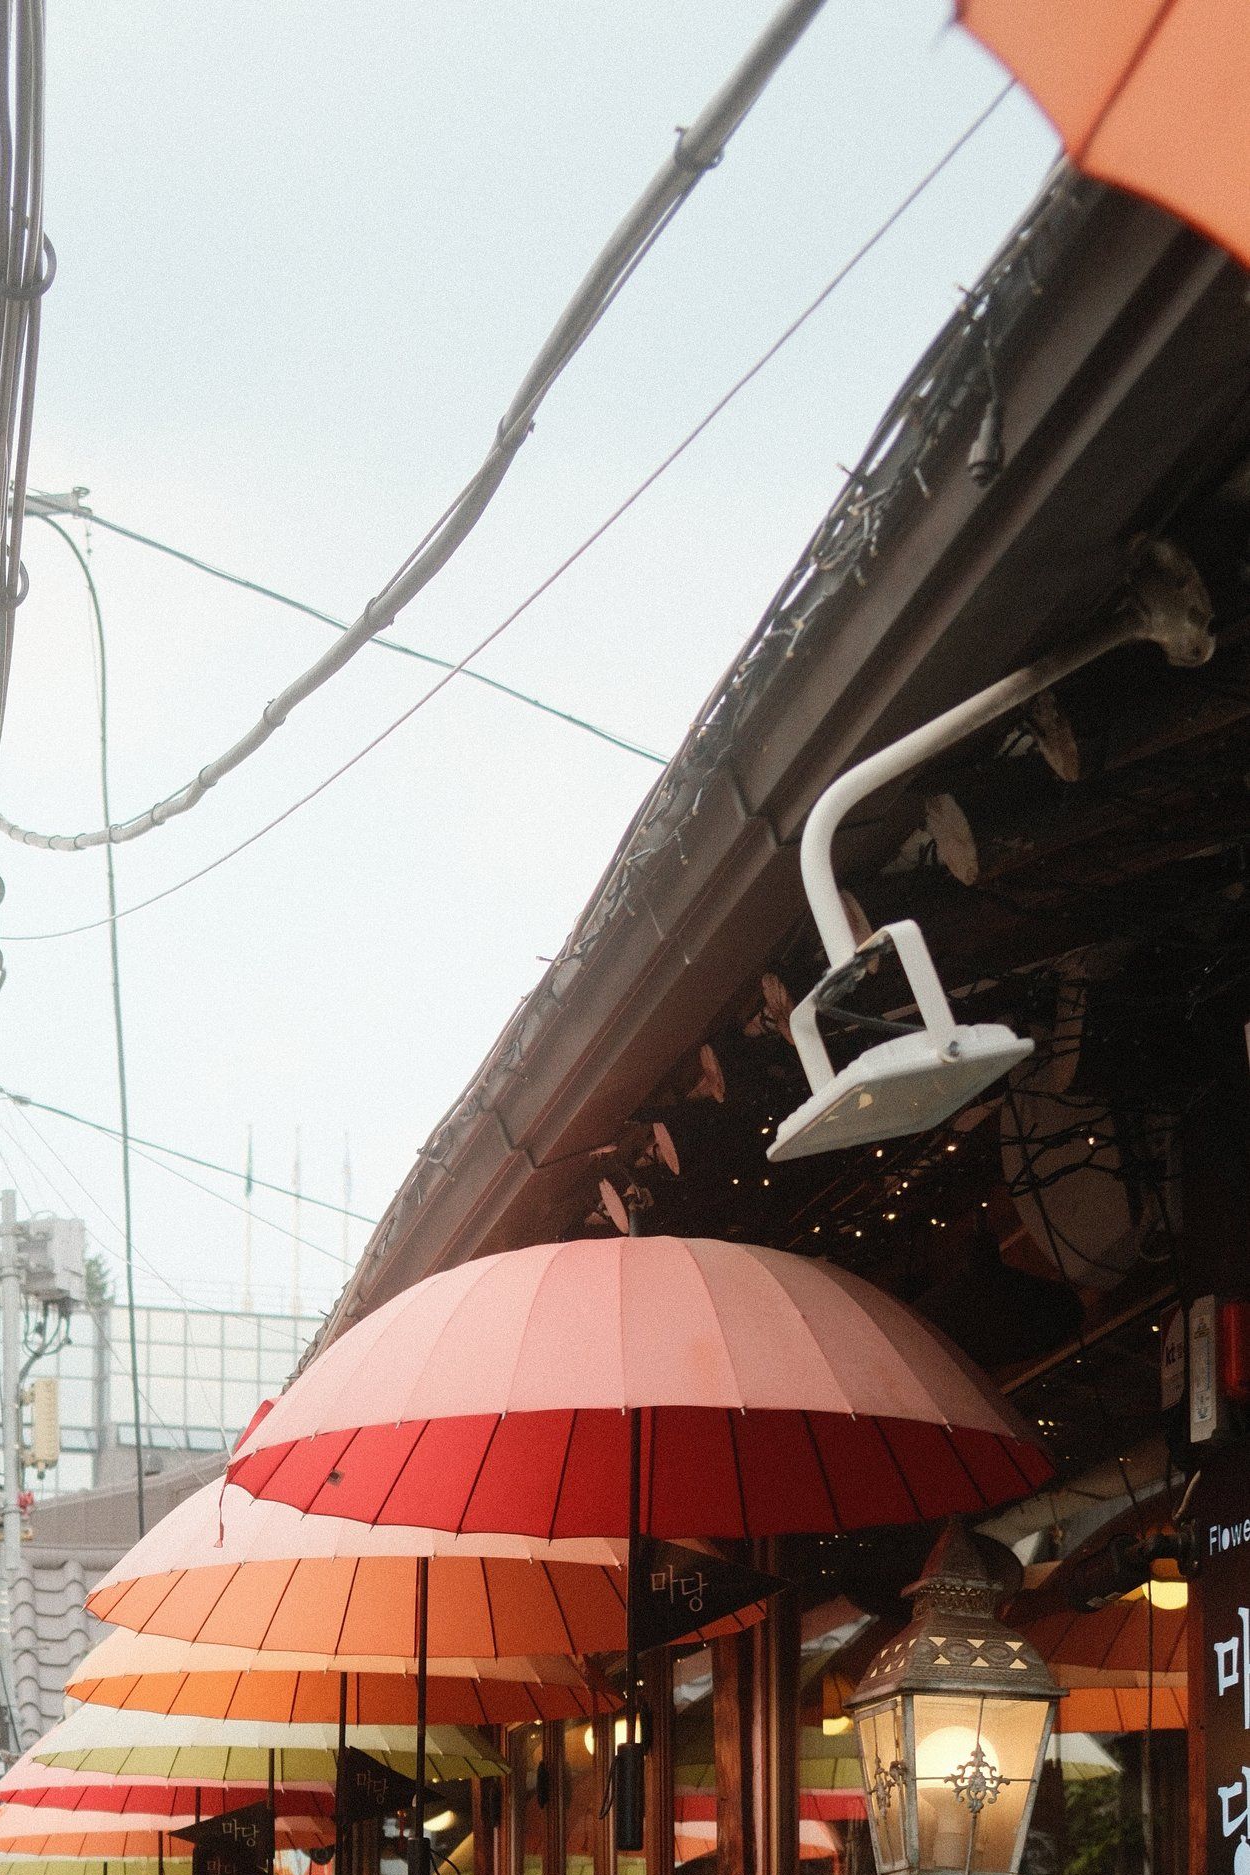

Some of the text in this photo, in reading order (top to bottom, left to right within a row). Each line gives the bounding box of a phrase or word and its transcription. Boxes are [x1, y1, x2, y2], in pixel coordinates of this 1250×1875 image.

[650, 1564, 708, 1613] 마당
[356, 1770, 388, 1805] 마당
[221, 1818, 260, 1847] 마당
